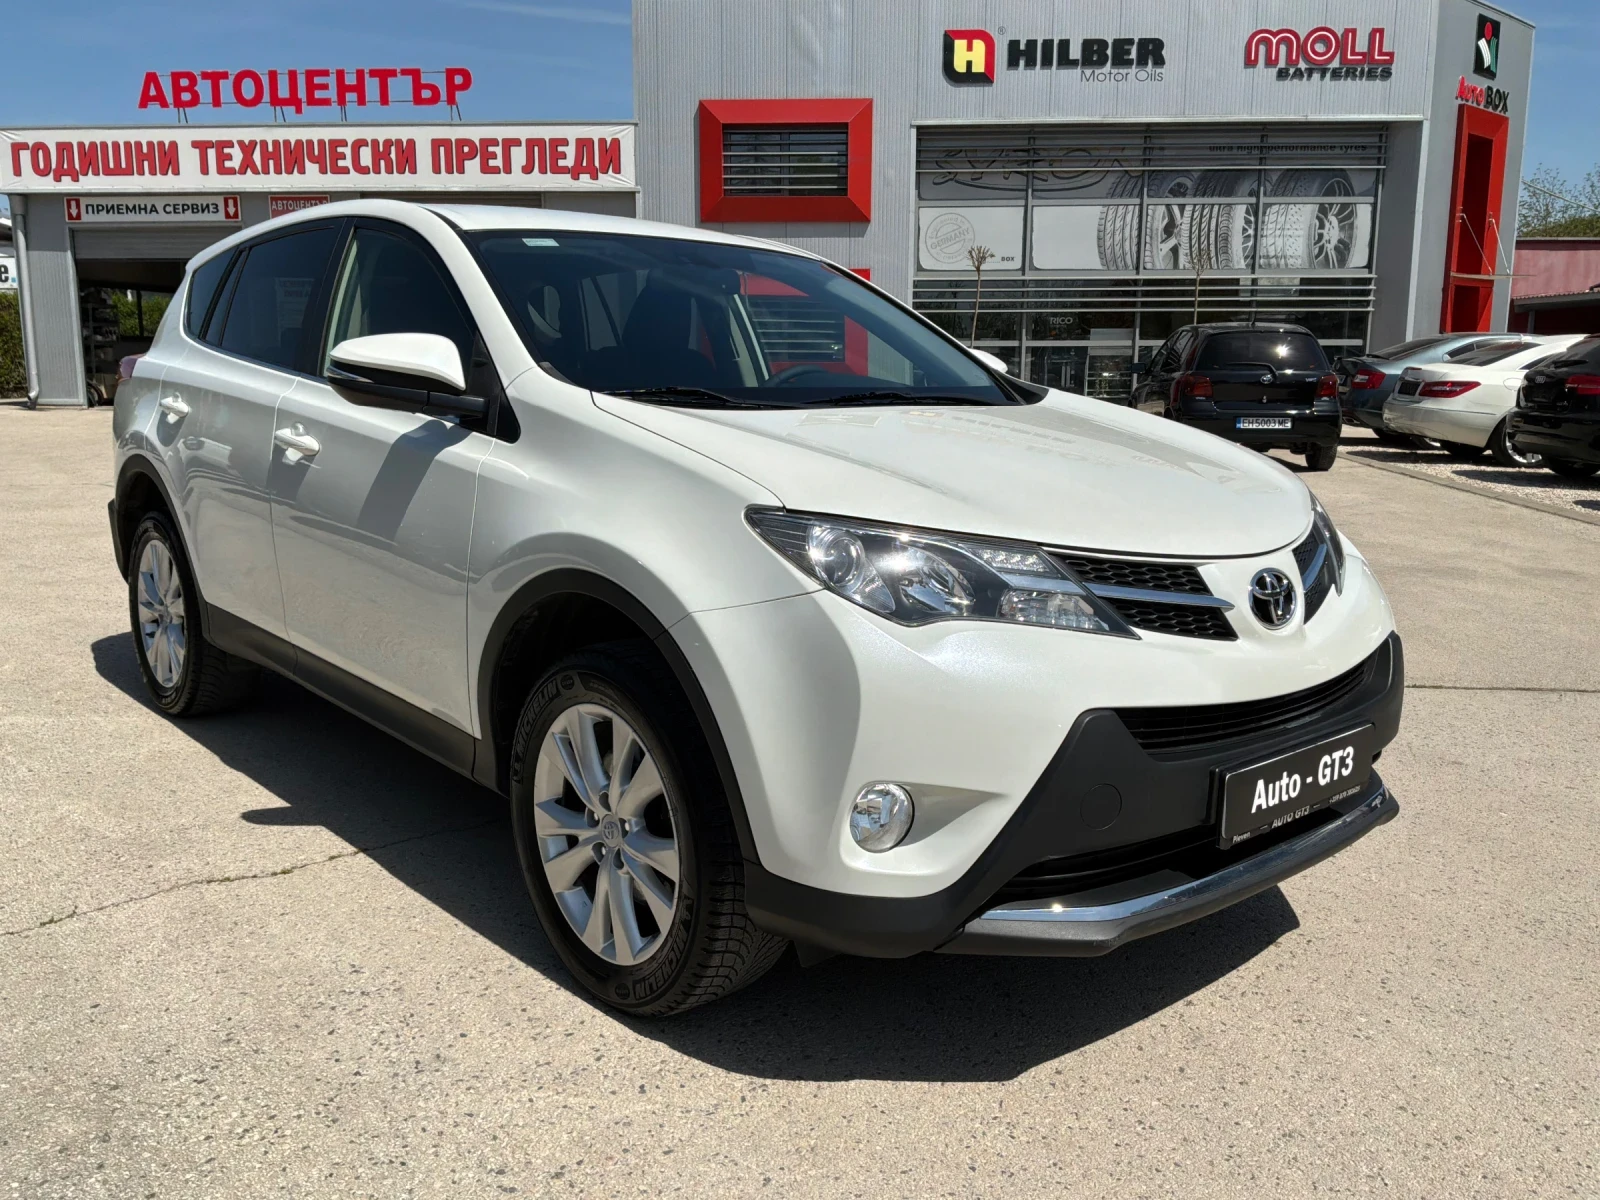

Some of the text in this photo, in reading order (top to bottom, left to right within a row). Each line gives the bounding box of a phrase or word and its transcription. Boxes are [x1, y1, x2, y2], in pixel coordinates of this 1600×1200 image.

[1007, 38, 1166, 69] HILBER
[1080, 69, 1164, 83] Motor Oils
[1276, 67, 1393, 80] BATTERIES
[138, 67, 473, 115] АВТОЦЕНТЪР
[10, 137, 622, 182] ГОДИШНИ ТЕХНИЧЕСКИ ПРЕГЛЕДИ
[85, 202, 220, 215] ПРИЕМНА СЕРВИЗ
[930, 227, 970, 250] GERMANY
[516, 677, 558, 758] MICHELIN
[1251, 771, 1301, 814] Auto
[1318, 746, 1354, 787] GT3
[1271, 813, 1294, 829] AUTO
[1294, 805, 1310, 819] GT3
